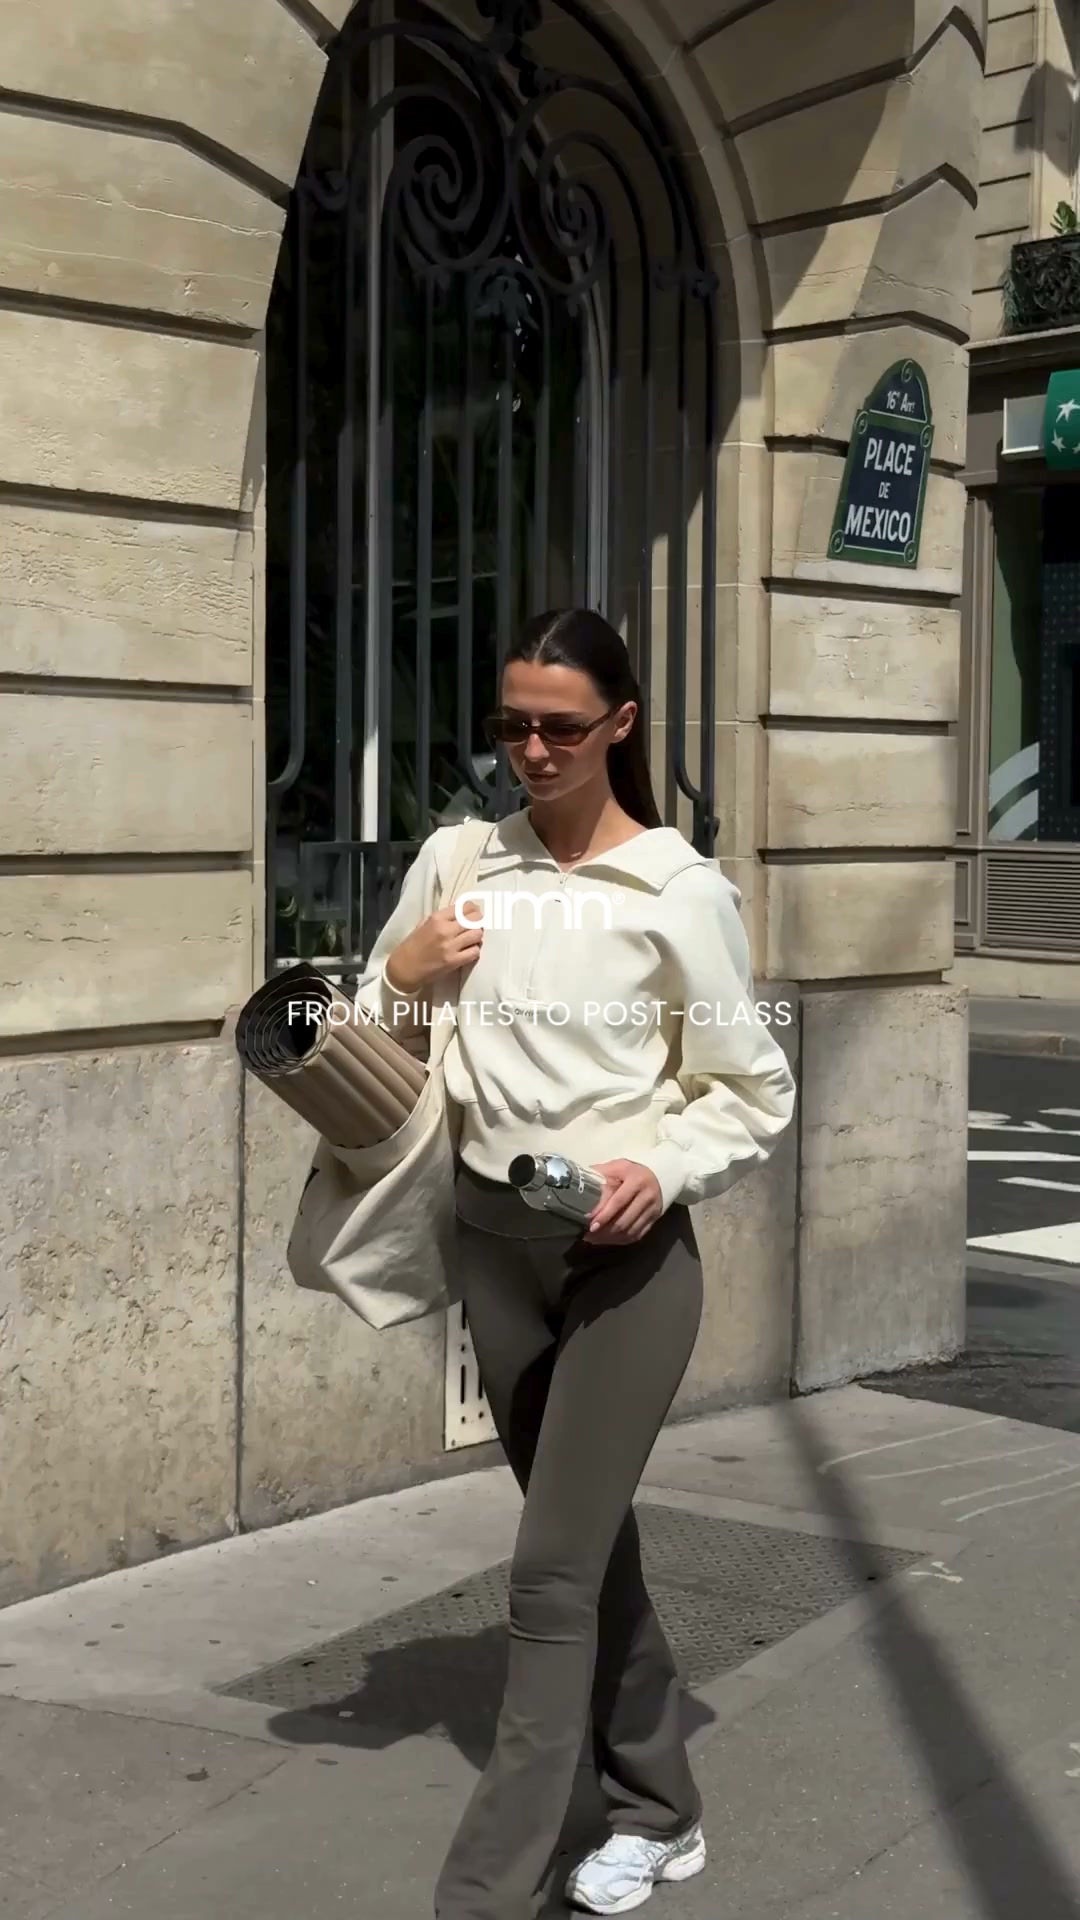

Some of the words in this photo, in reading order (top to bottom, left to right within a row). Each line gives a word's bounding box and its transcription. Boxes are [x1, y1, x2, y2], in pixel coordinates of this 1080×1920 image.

[863, 437, 916, 476] PLACE
[877, 481, 892, 499] DE
[844, 503, 912, 543] MEXICO
